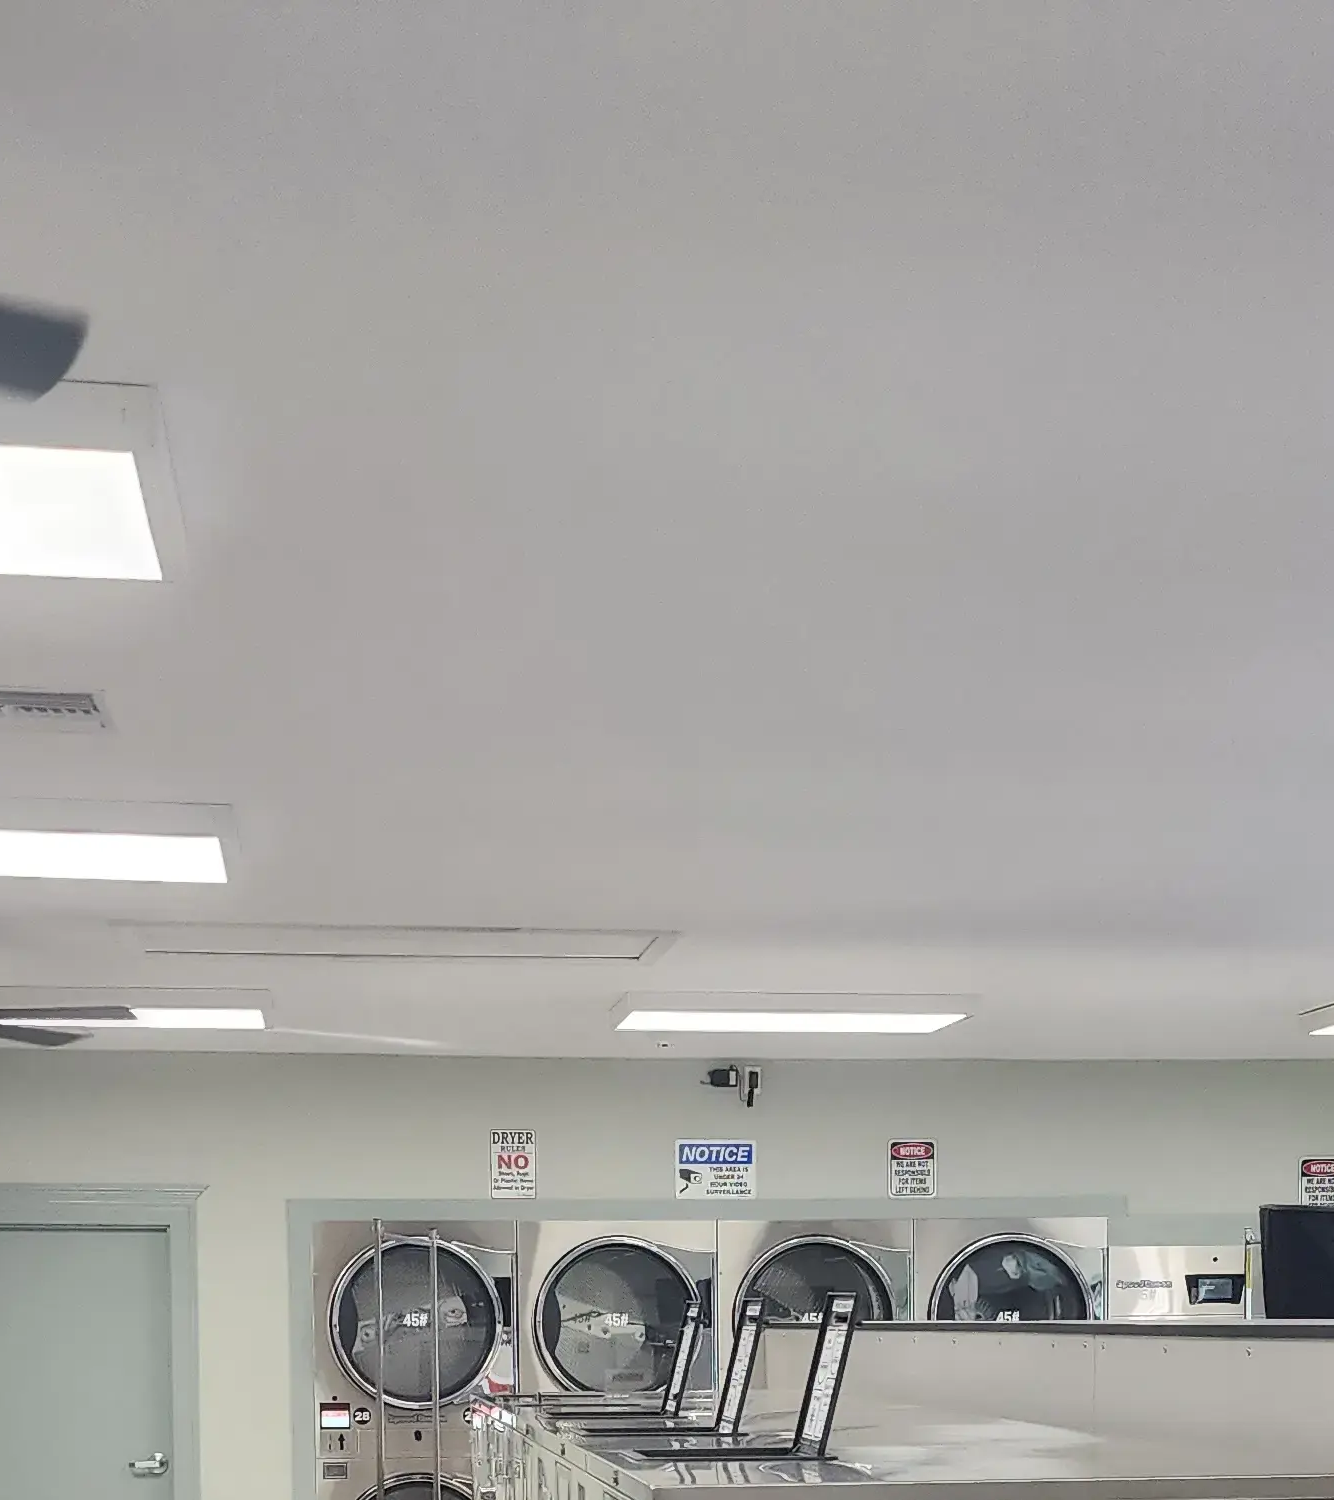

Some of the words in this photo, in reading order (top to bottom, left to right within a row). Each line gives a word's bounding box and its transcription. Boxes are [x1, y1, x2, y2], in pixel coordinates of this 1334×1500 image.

[492, 1131, 534, 1145] DRYER
[500, 1145, 526, 1153] RULES
[682, 1146, 750, 1162] NOTICE
[899, 1146, 926, 1156] NOTICE
[497, 1154, 530, 1170] NO
[917, 1160, 929, 1168] NOT
[910, 1177, 927, 1185] ITEMS
[402, 1313, 428, 1327] 45#
[605, 1313, 629, 1327] 45#
[354, 1411, 372, 1421] 28
